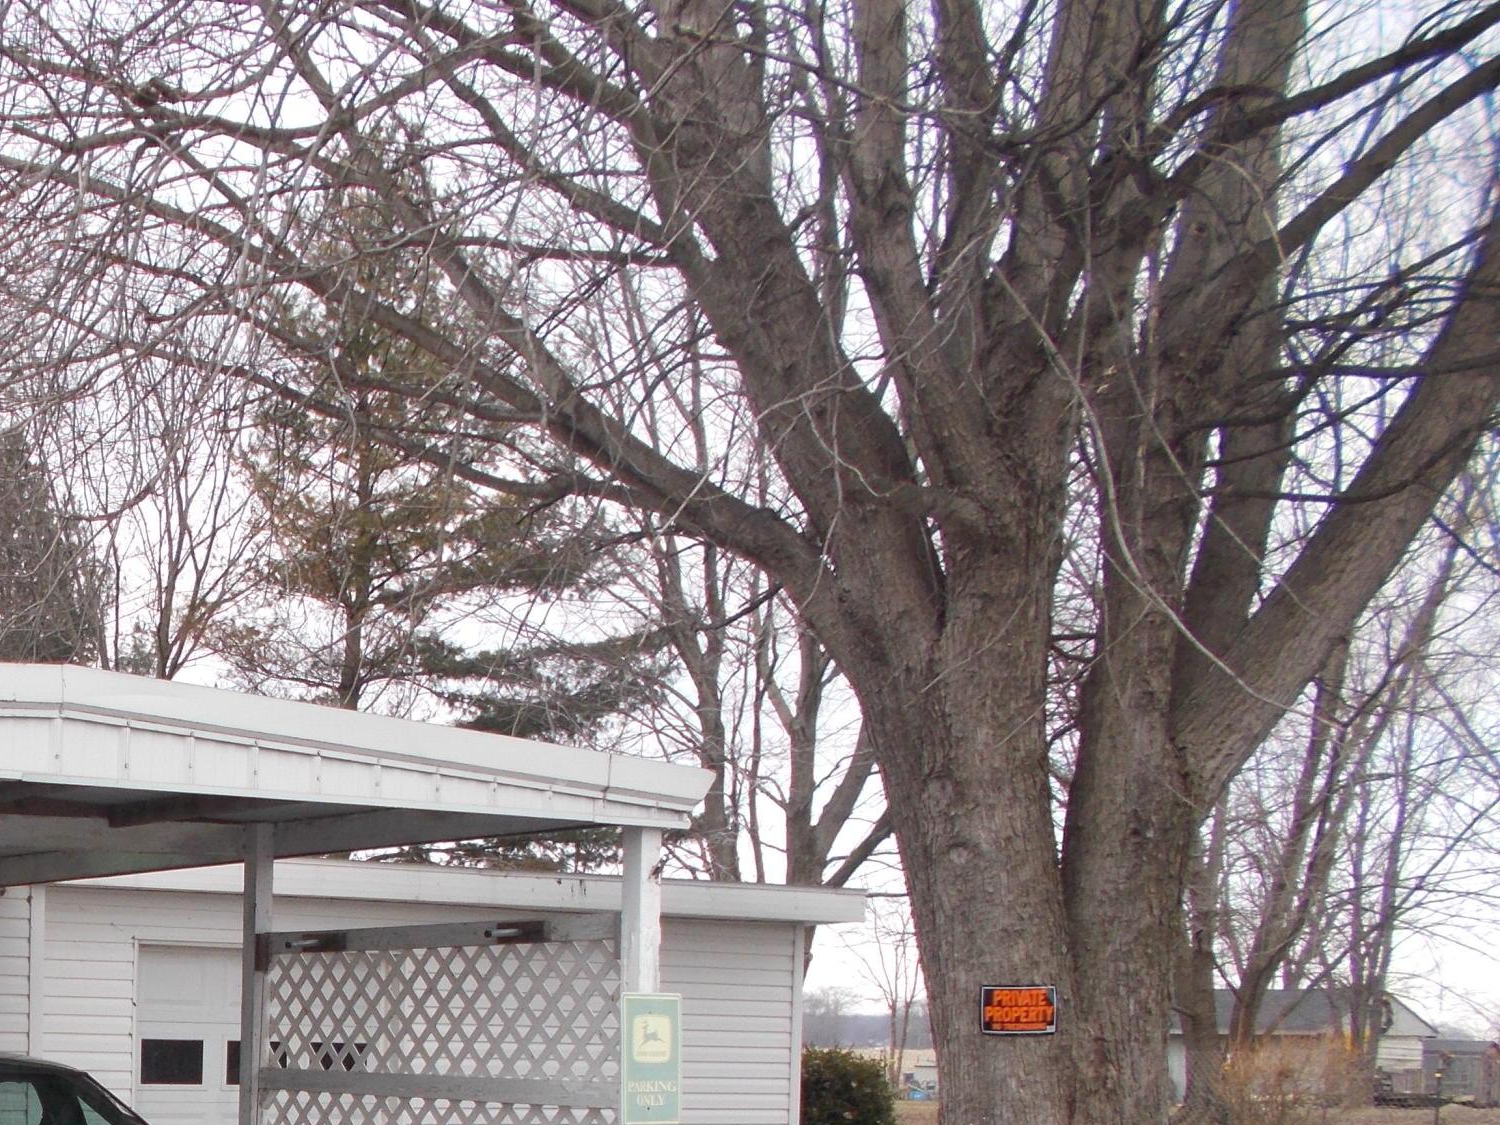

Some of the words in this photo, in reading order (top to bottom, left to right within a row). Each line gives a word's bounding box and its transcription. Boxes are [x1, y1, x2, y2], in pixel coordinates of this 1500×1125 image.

[994, 990, 1047, 1006] PRIVATE
[984, 1006, 1054, 1022] PROPERTY
[627, 1080, 677, 1093] PARKING
[636, 1094, 666, 1106] ONLY
